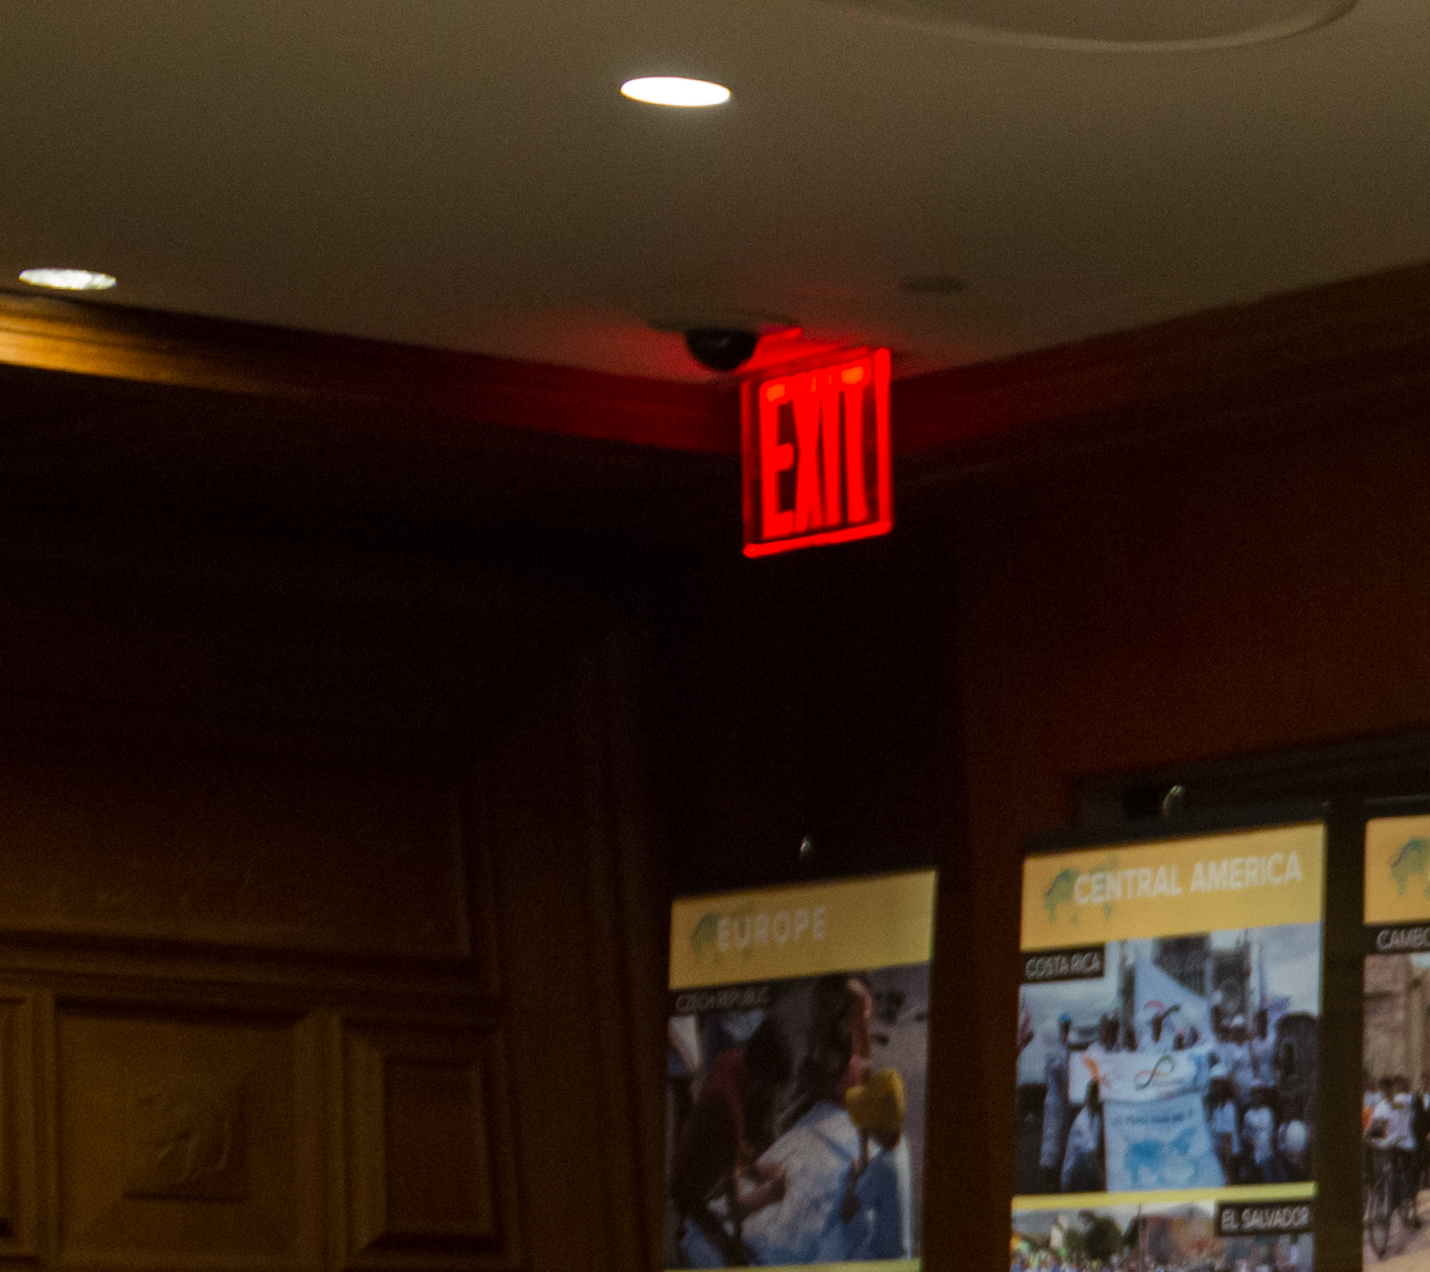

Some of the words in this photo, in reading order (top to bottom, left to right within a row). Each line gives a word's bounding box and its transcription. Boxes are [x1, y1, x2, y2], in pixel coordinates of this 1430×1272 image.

[759, 358, 872, 540] EXIT
[1073, 865, 1182, 905] CENTRAL
[1190, 852, 1303, 894] AMERICA
[717, 906, 827, 951] EUROPE
[1026, 954, 1069, 980] COSTA
[1071, 952, 1101, 974] RICA
[1221, 1208, 1239, 1231] EL
[1241, 1205, 1309, 1229] SALVADOR
